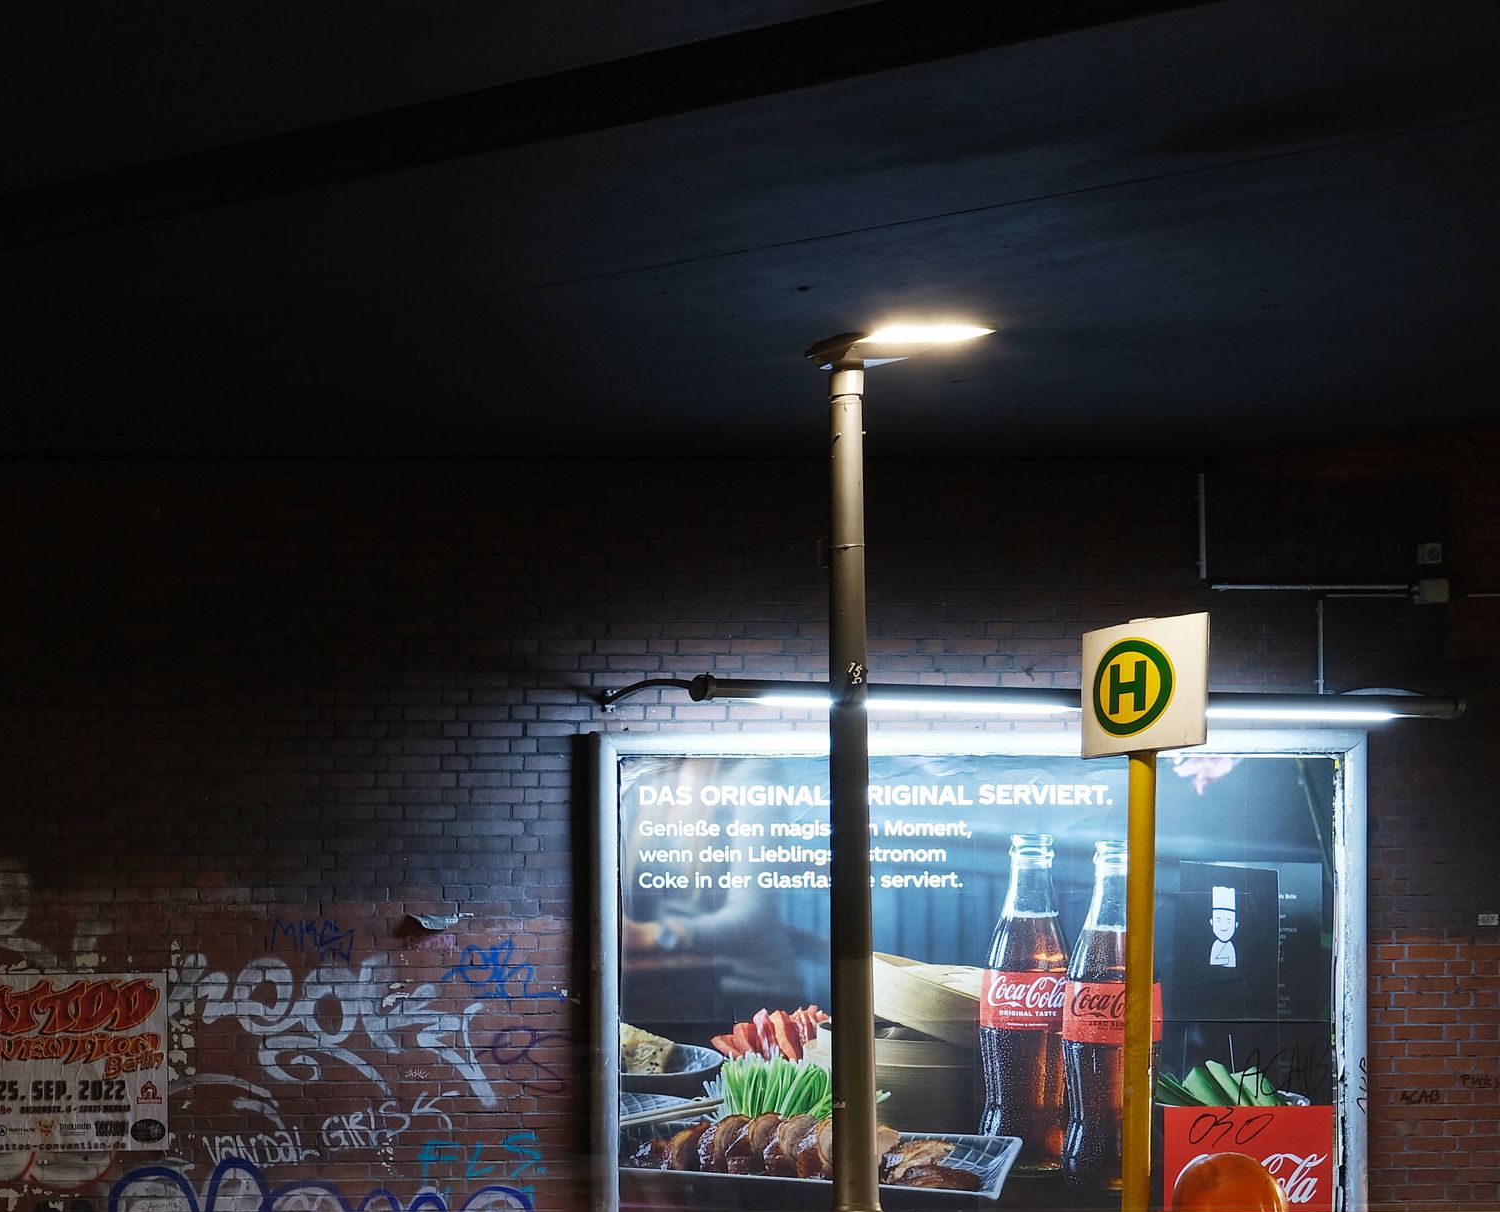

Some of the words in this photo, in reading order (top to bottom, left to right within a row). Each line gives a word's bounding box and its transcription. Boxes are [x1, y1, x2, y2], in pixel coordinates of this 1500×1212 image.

[639, 786, 692, 806] DAS
[699, 785, 831, 806] ORIGINAL
[867, 784, 973, 806] RIGINAL
[979, 784, 1113, 806] SERVIERT.
[639, 820, 720, 838] Genieße
[726, 820, 764, 838] den
[770, 820, 884, 840] magisn
[890, 820, 973, 840] Moment,
[639, 849, 693, 863] wenn
[698, 845, 742, 863] dein
[639, 872, 688, 889] Coke
[695, 872, 710, 889] in
[719, 872, 752, 889] der
[881, 871, 963, 889] serviert.
[103, 1051, 164, 1080] Berlin
[31, 1080, 72, 1101] SEP.
[78, 1080, 126, 1100] 2022
